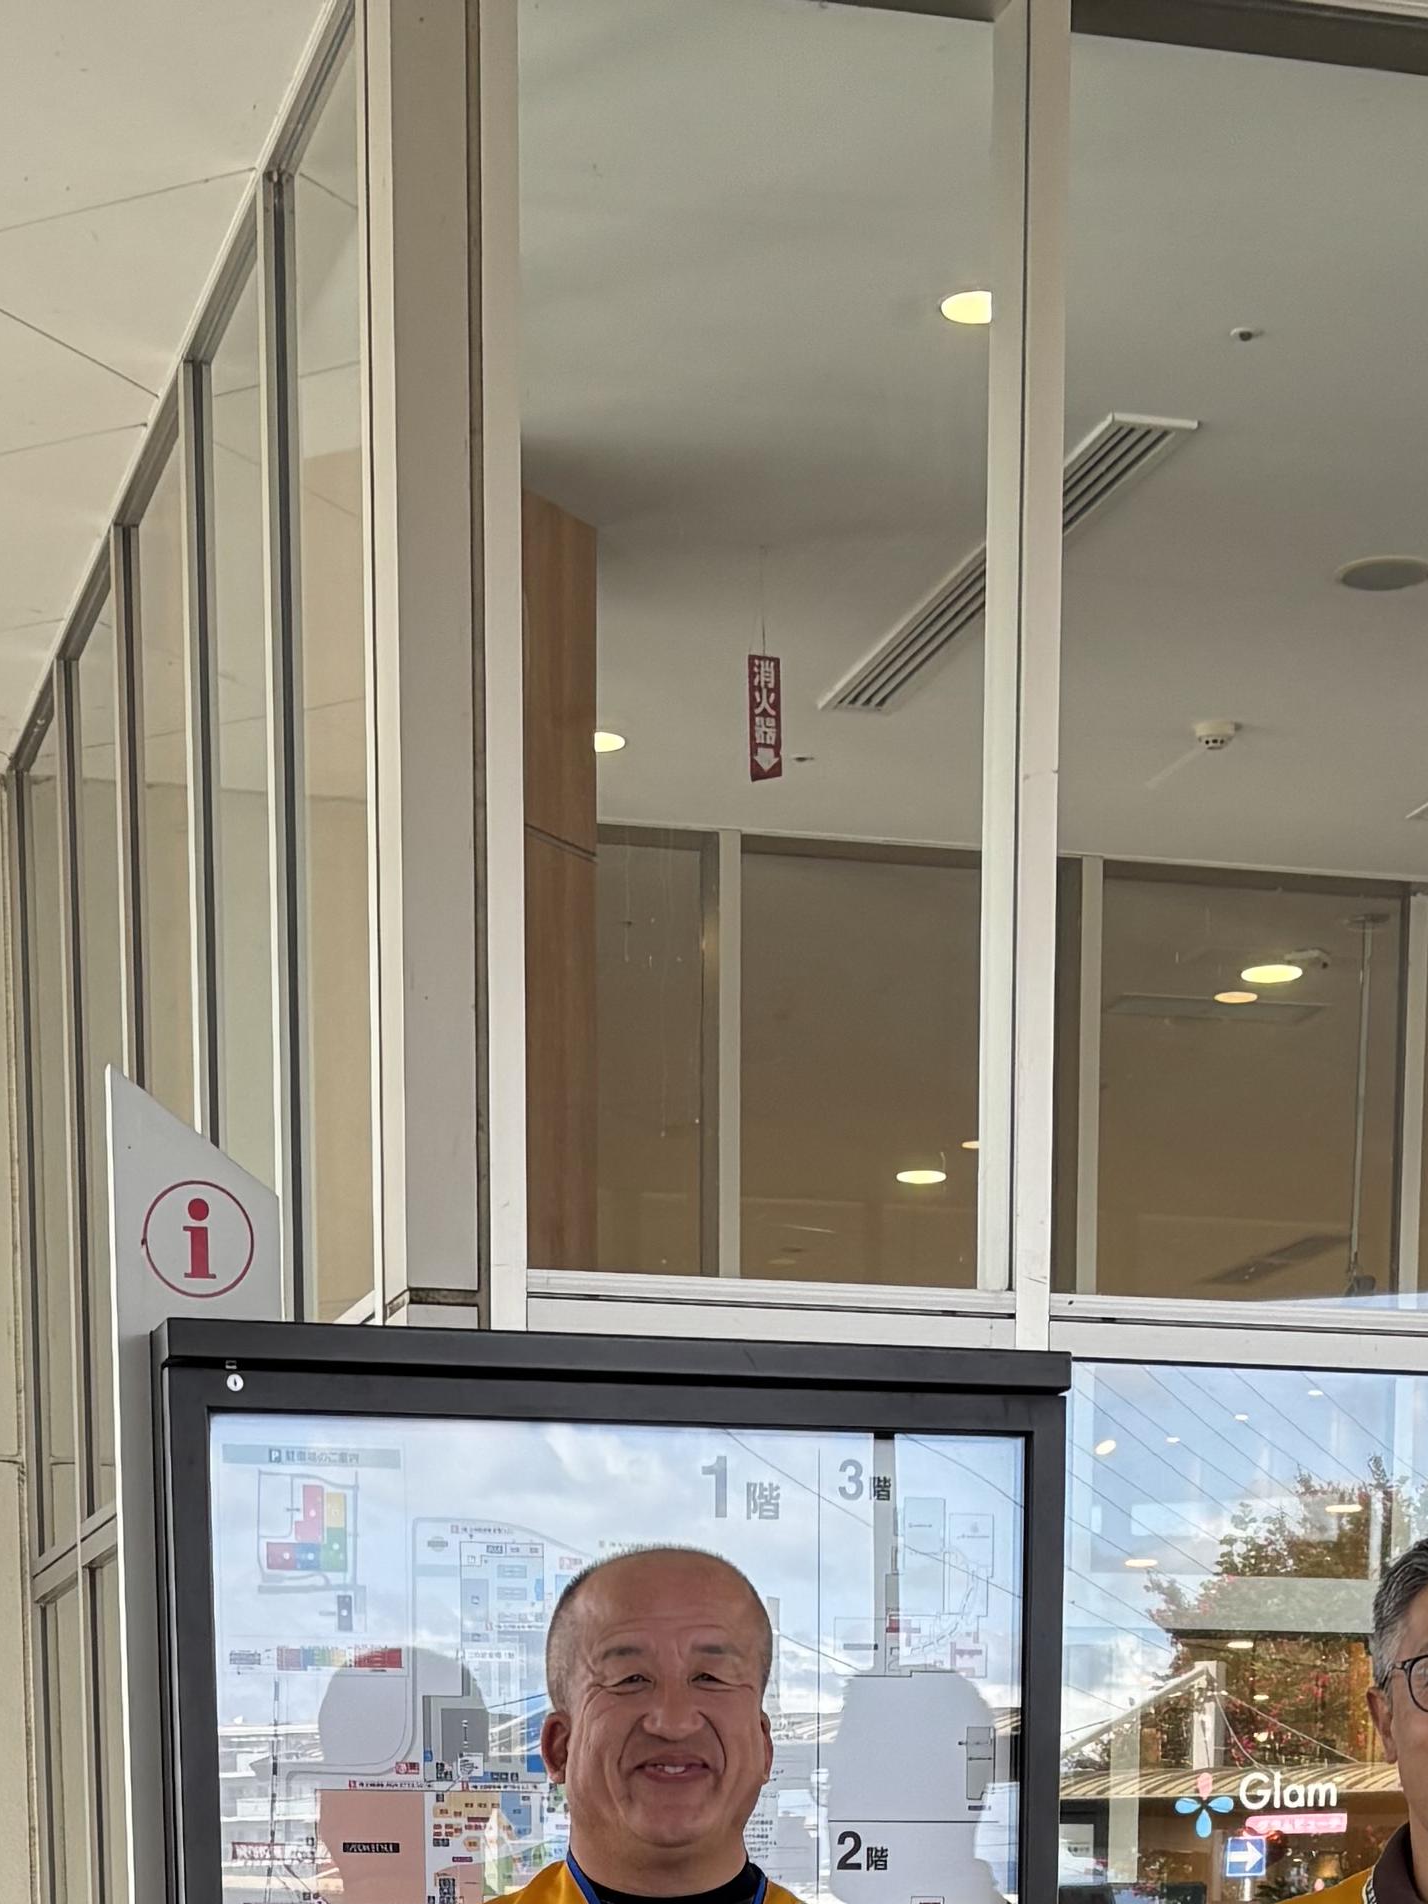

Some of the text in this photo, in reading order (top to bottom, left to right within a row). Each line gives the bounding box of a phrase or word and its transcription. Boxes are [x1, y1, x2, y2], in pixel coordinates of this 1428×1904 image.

[753, 659, 776, 745] 消火器
[701, 1455, 781, 1521] 1階
[838, 1458, 892, 1502] 3階
[1239, 1771, 1338, 1811] Glam
[836, 1830, 889, 1872] 2階
